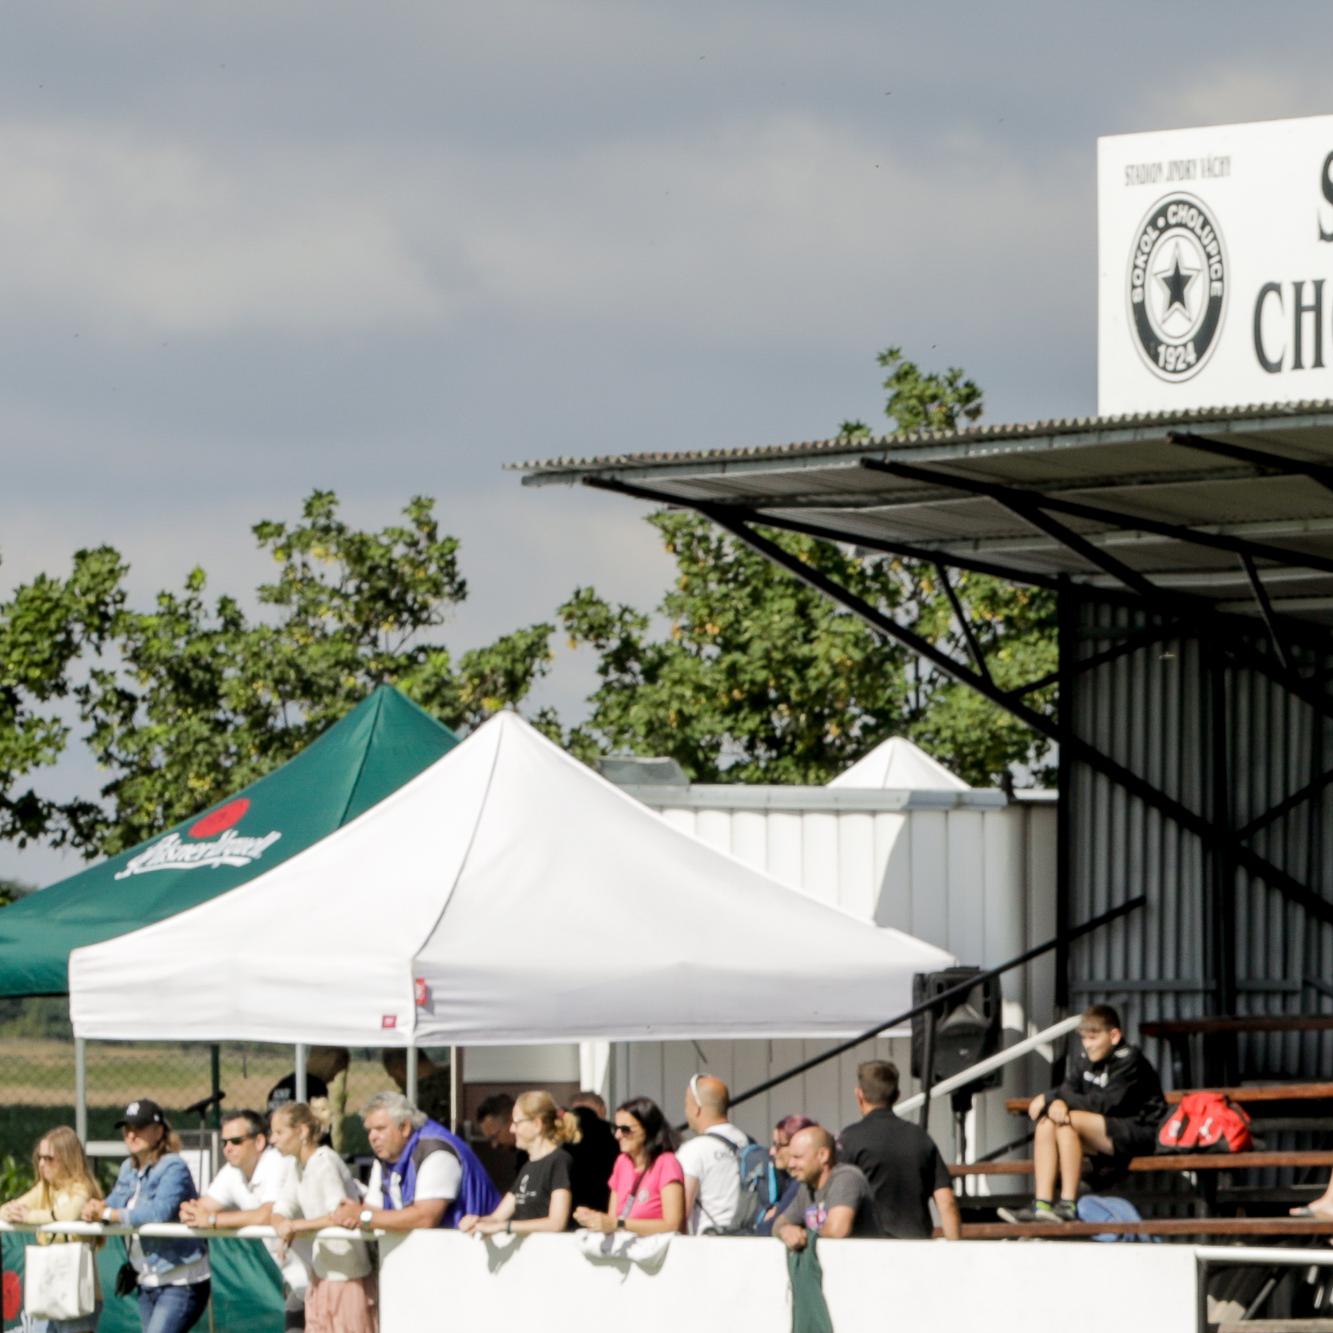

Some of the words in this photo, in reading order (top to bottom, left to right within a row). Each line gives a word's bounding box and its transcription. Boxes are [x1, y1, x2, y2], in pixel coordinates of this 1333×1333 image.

[1132, 224, 1160, 303] SOKOL
[1167, 204, 1224, 297] CHOLUPICE
[1157, 341, 1197, 371] 1924
